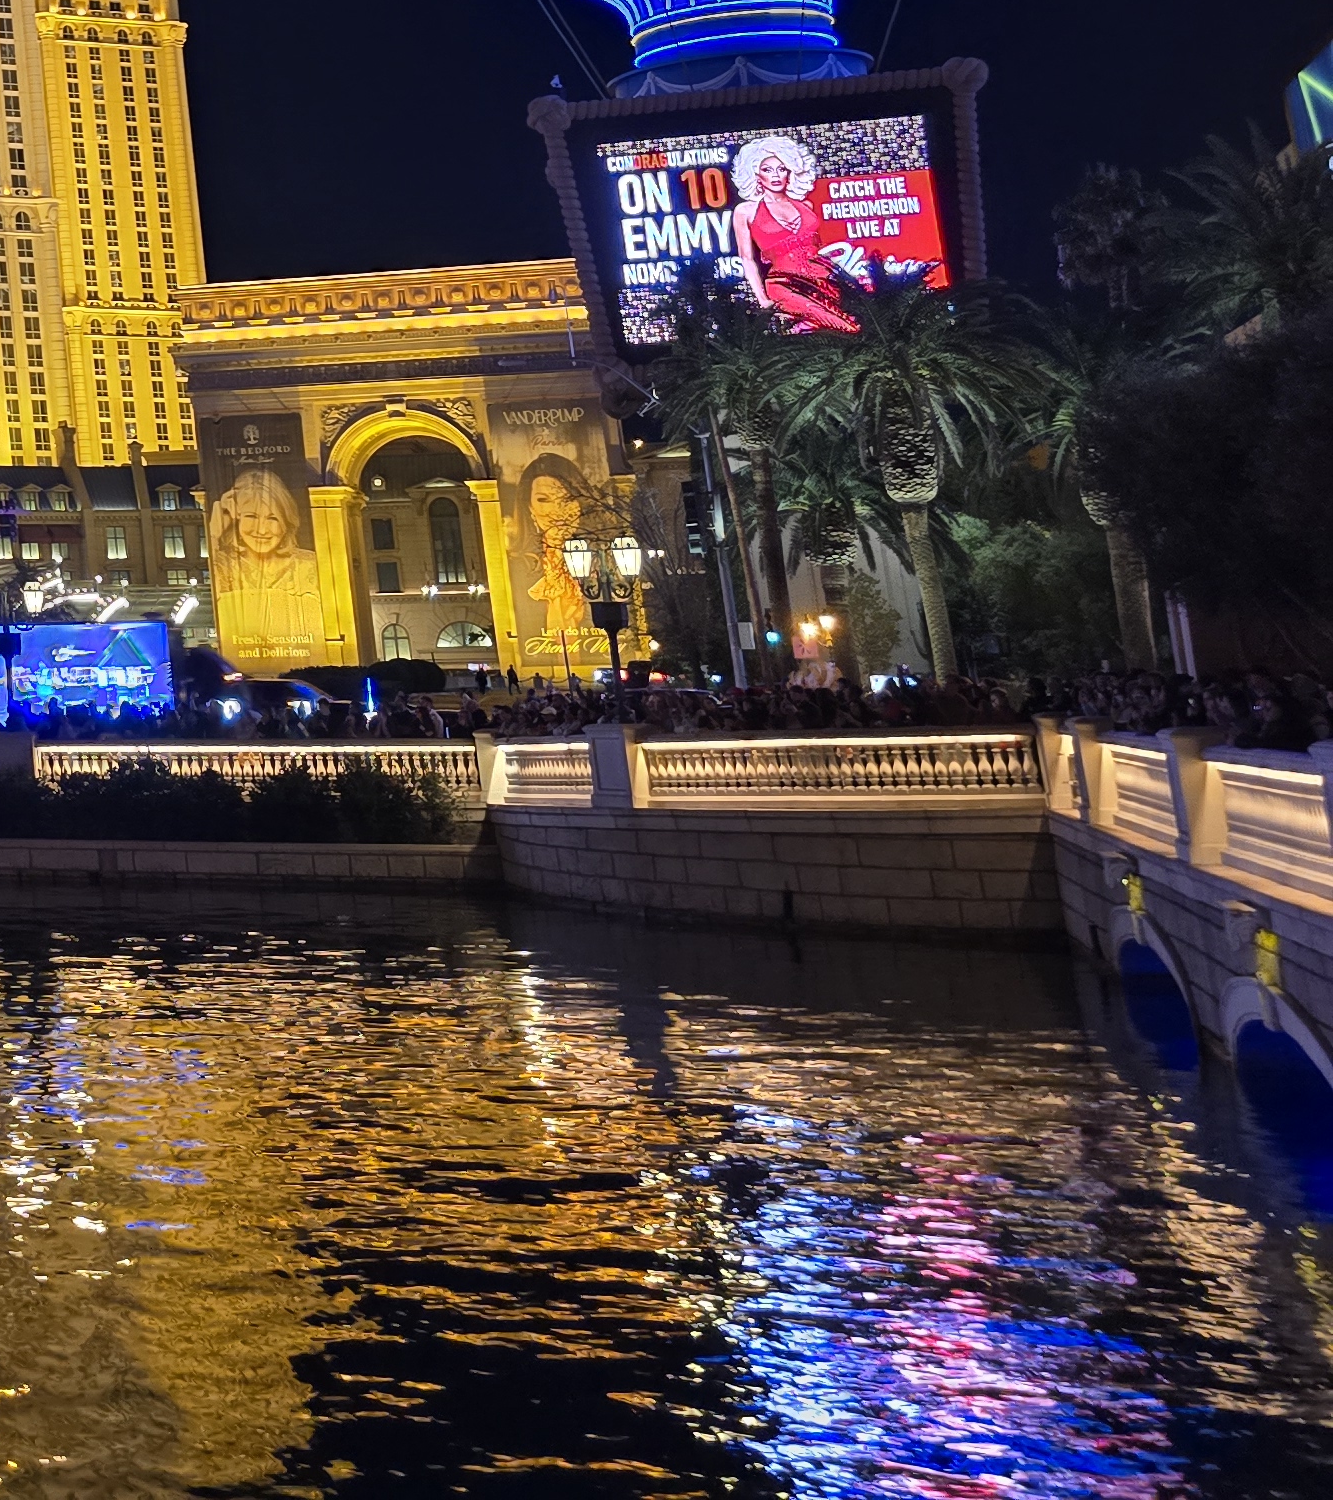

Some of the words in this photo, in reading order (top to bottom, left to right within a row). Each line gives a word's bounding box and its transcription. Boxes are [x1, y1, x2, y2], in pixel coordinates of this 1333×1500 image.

[618, 171, 672, 215] ON
[681, 168, 727, 210] 10
[829, 180, 874, 199] CATCH
[876, 177, 906, 195] THE
[822, 197, 920, 220] PHENOMENON
[622, 211, 733, 260] EMMY
[847, 220, 880, 238] LIVE
[883, 219, 900, 236] AT
[216, 447, 237, 456] THE
[240, 445, 291, 455] BEDFORD
[267, 633, 314, 644] Seasonal
[565, 626, 579, 636] do
[239, 647, 261, 658] and
